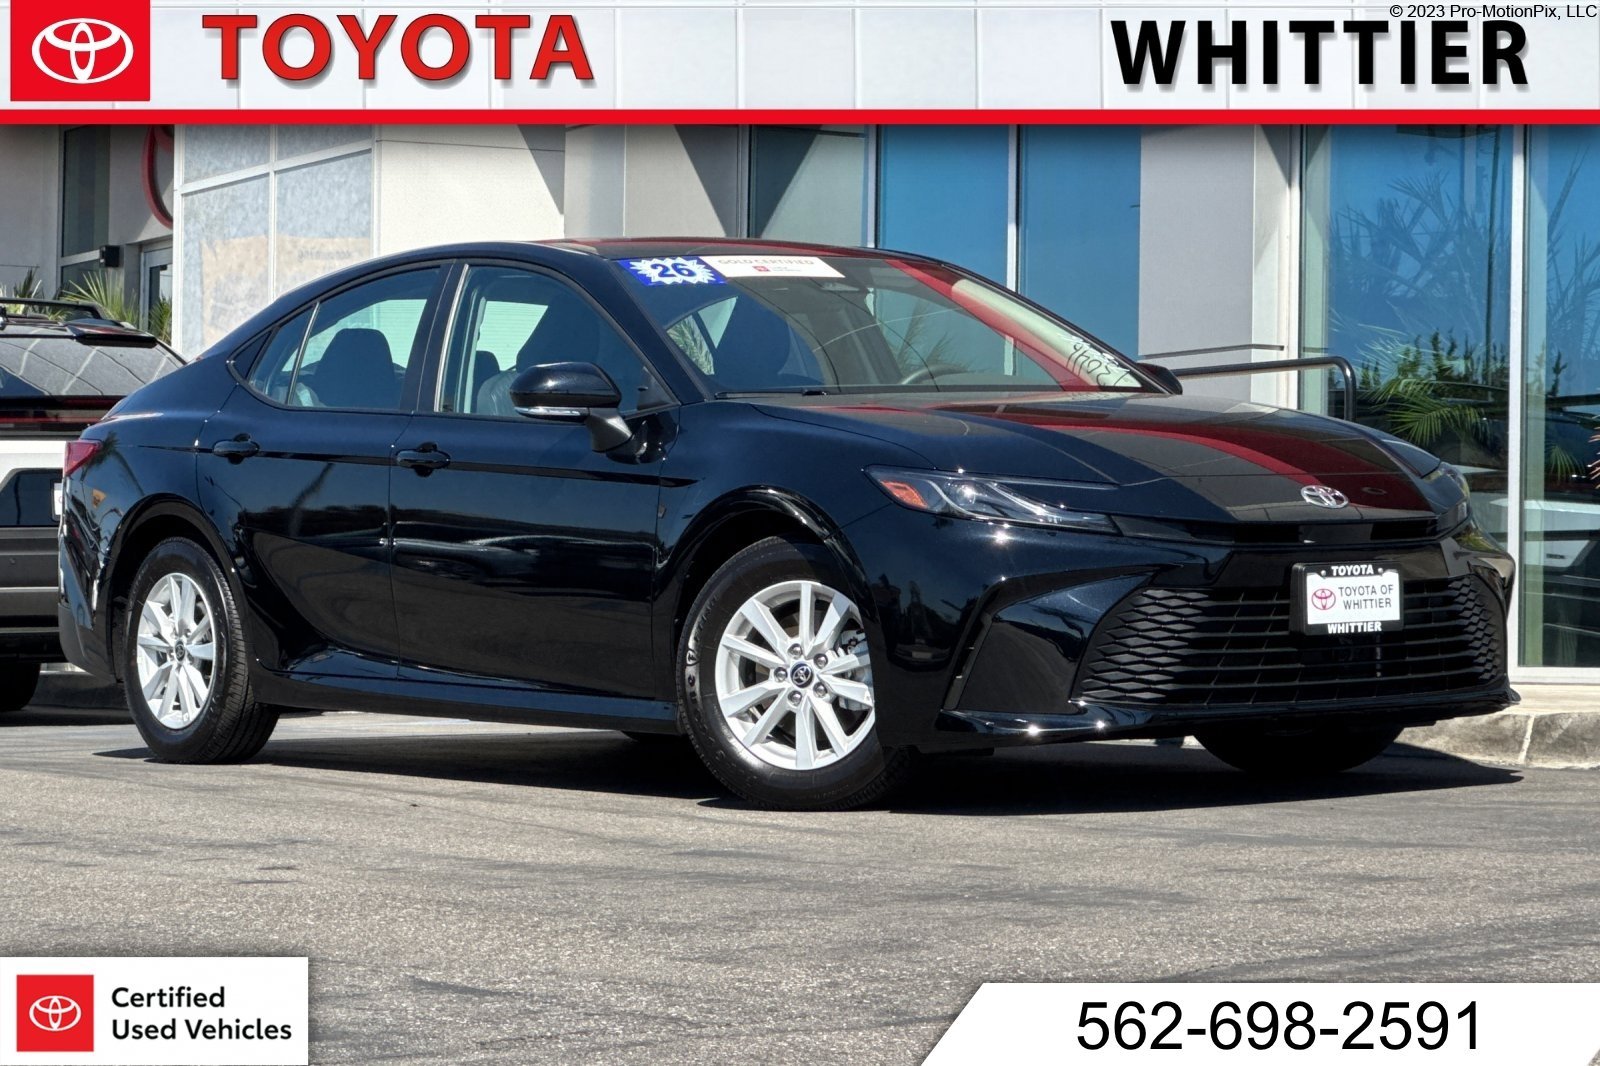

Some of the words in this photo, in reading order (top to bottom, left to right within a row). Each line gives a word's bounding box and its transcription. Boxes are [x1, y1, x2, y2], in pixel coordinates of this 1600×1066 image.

[651, 262, 697, 278] 26
[1331, 564, 1374, 576] TOYOTA
[1338, 586, 1377, 597] TOYOTA
[1380, 585, 1393, 595] OF
[1343, 598, 1391, 609] WHITTIER
[1328, 621, 1382, 633] WHITTIER
